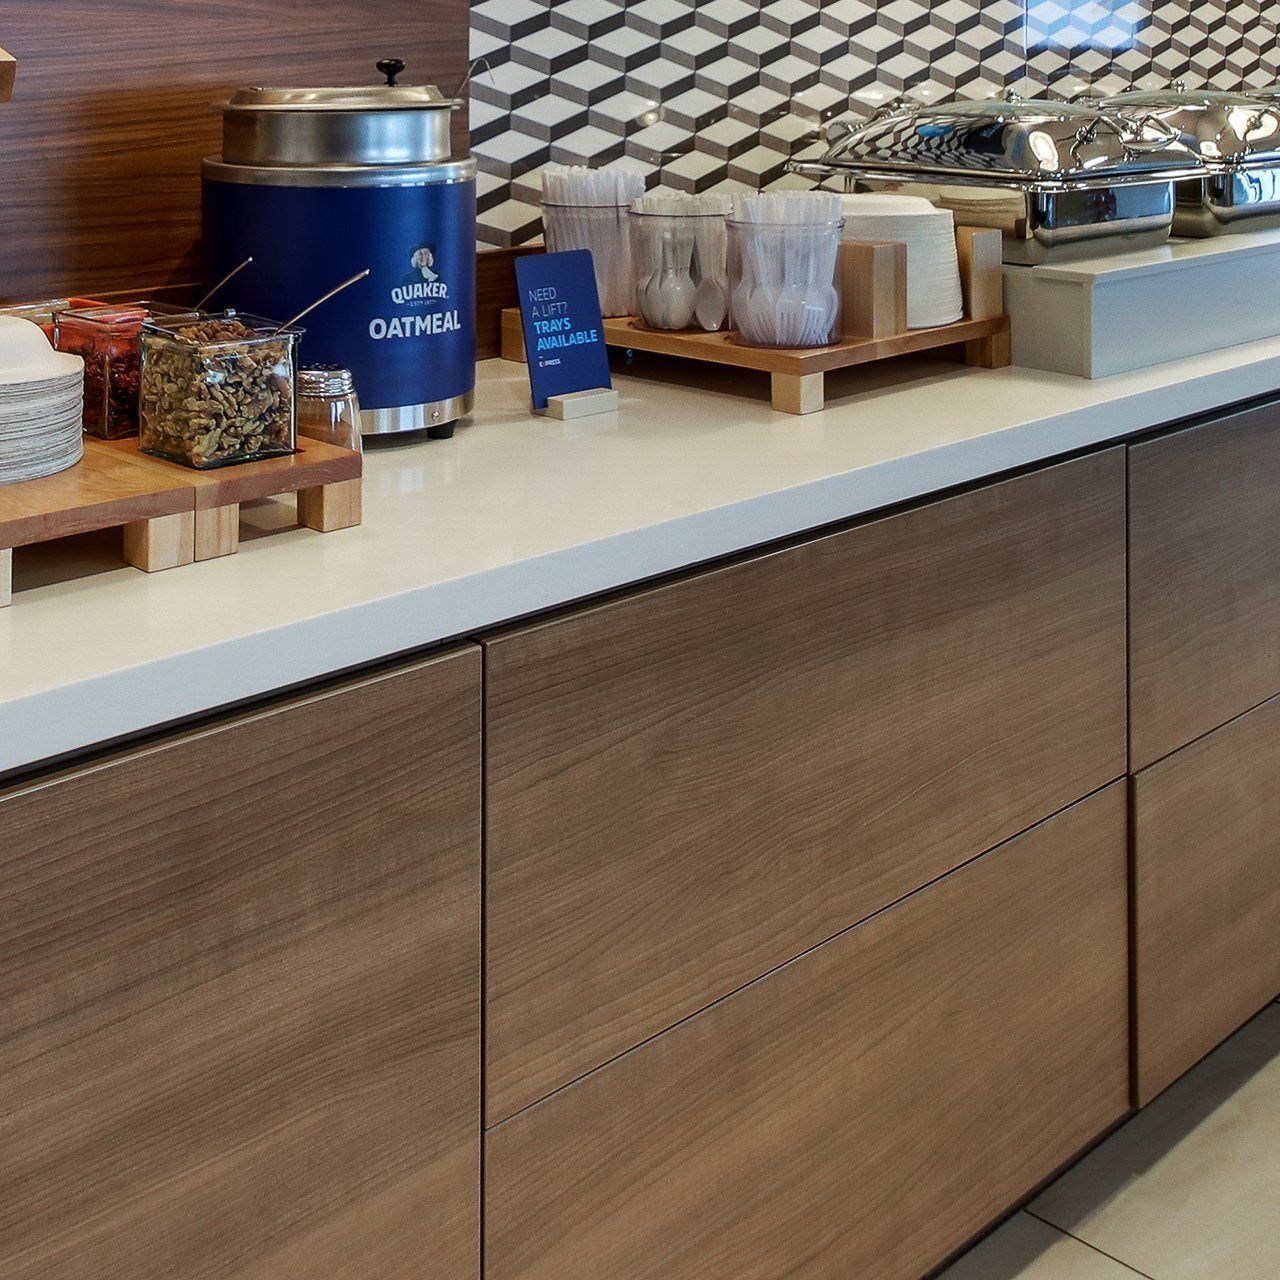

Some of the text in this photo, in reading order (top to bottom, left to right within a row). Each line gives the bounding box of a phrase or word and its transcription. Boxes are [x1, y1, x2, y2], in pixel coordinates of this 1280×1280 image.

[391, 282, 448, 304] QUAKER
[528, 287, 557, 302] NEED
[531, 302, 568, 318] A LIFT?
[369, 310, 461, 340] OATMEAL
[534, 317, 571, 334] TRAYS
[537, 329, 598, 351] AVAILABLE
